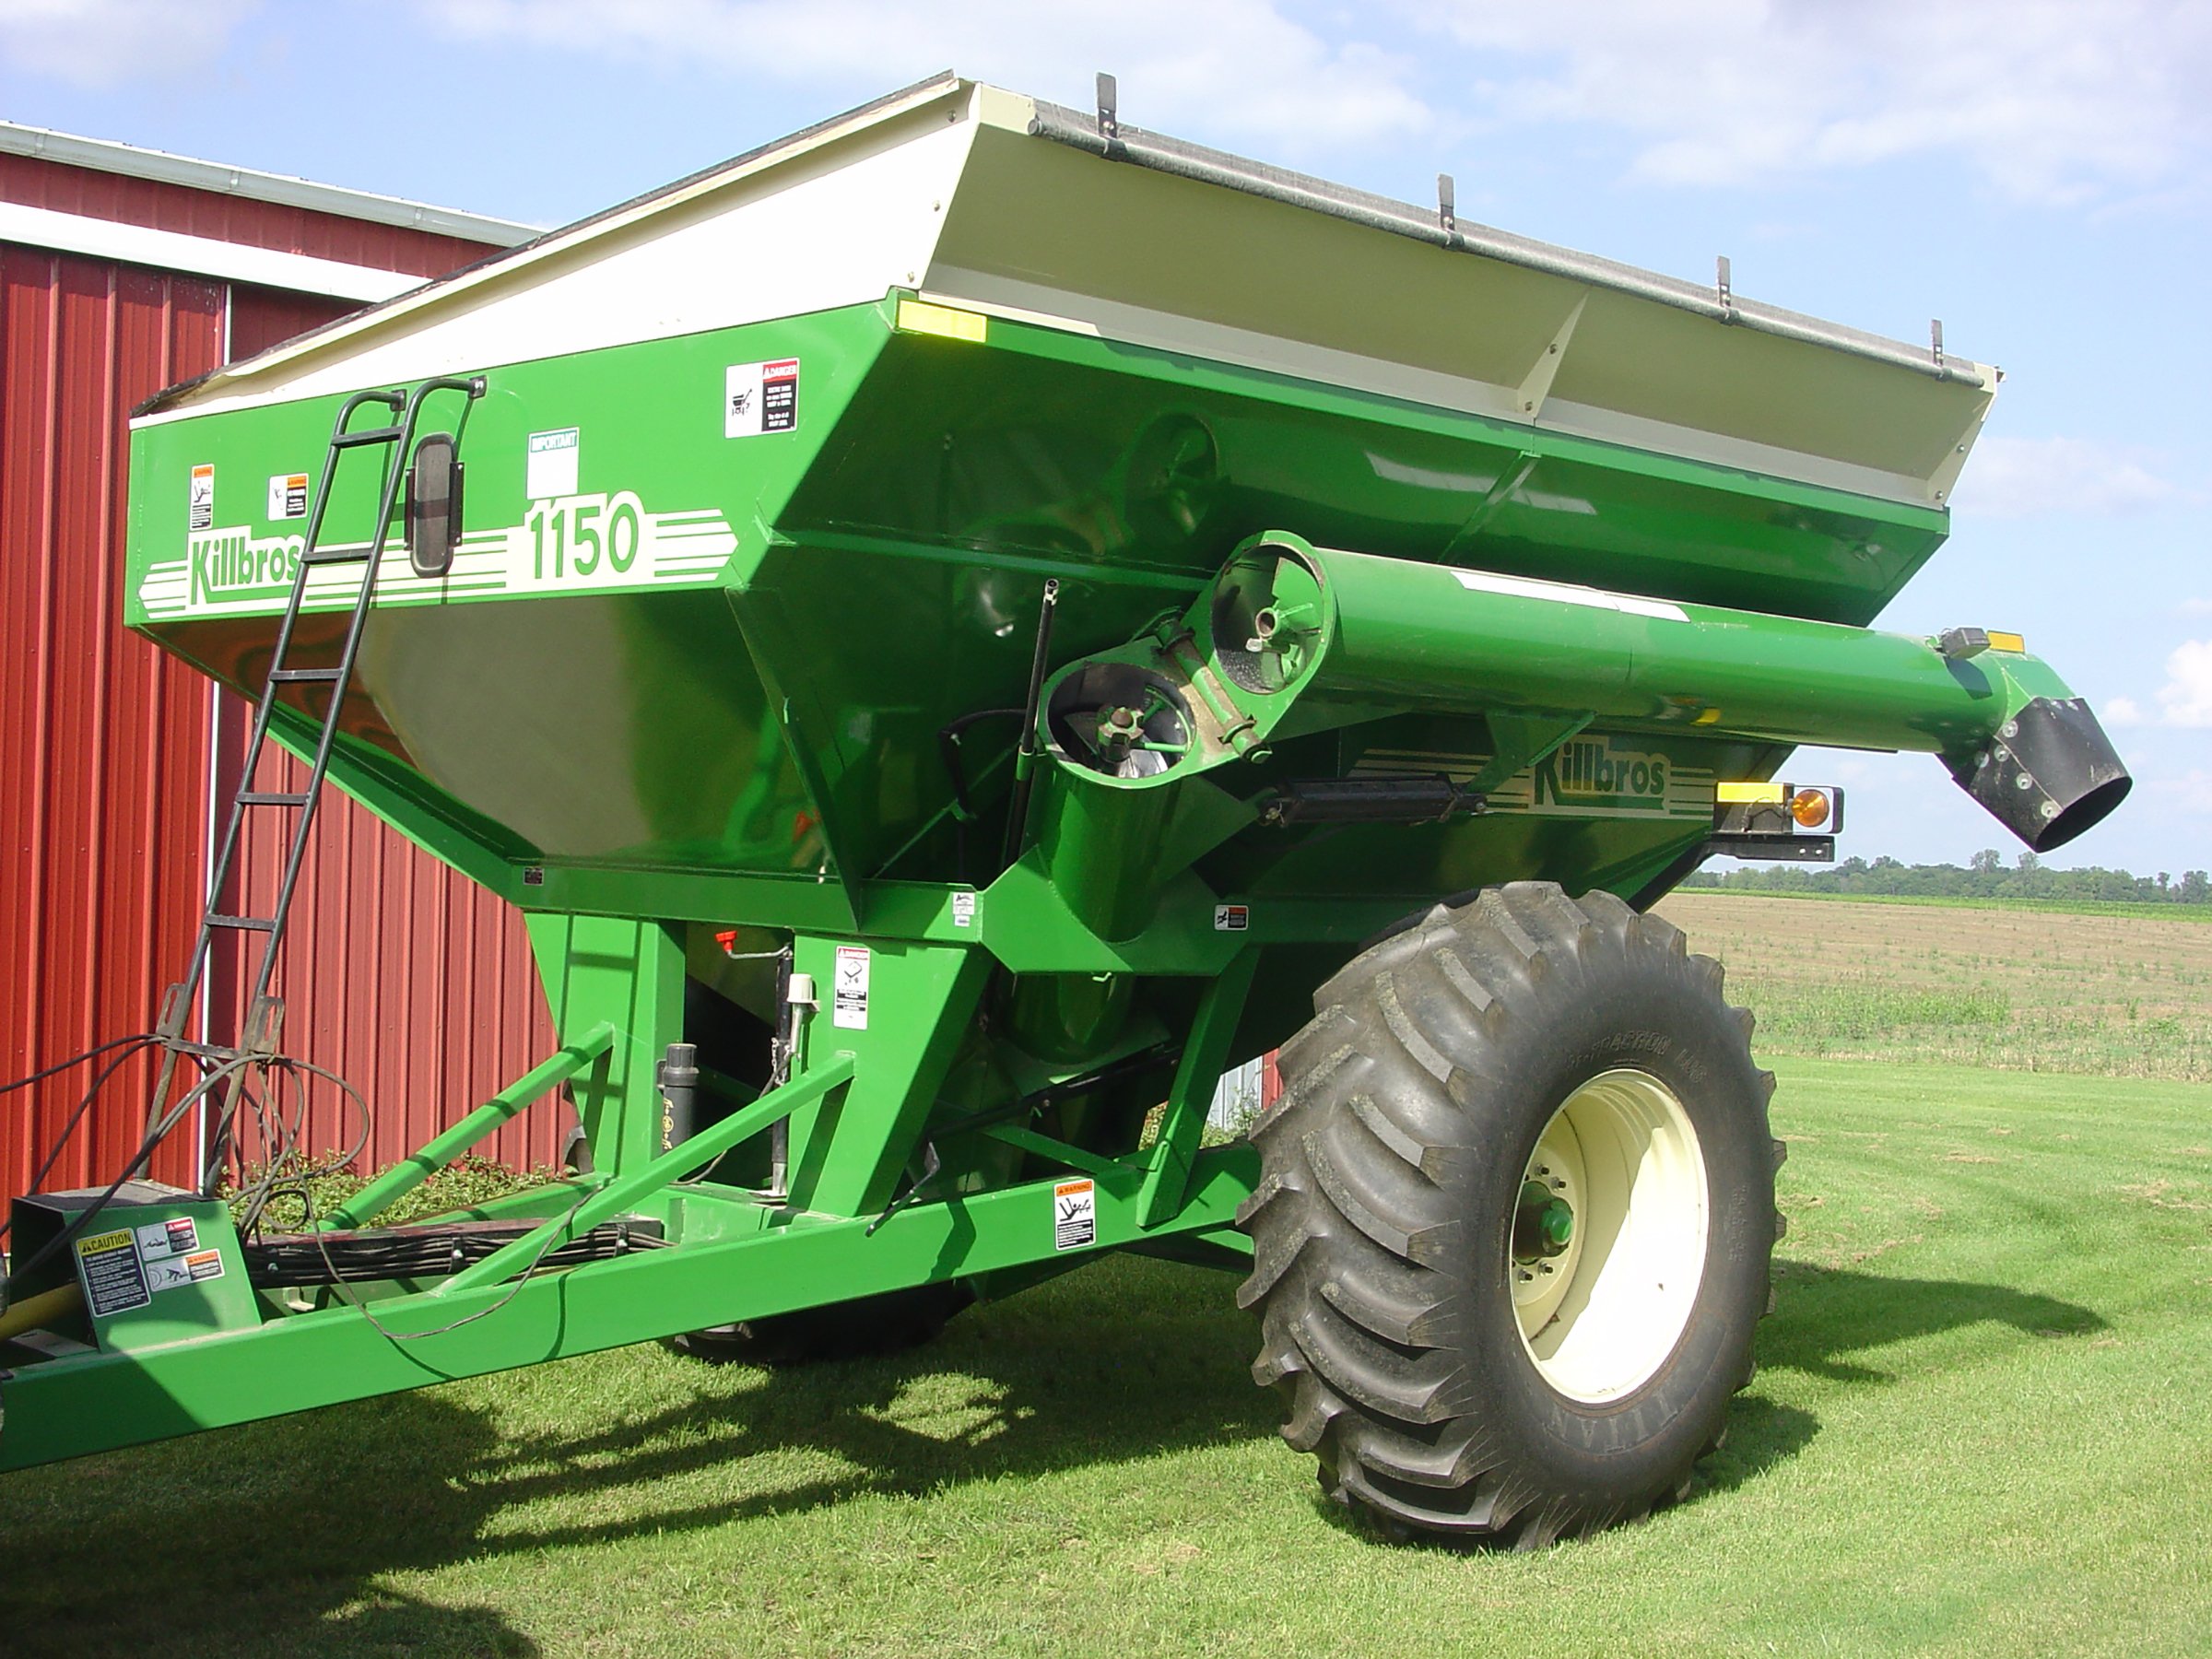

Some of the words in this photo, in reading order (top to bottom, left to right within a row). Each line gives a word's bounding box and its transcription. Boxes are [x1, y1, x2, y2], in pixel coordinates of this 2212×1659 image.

[190, 535, 300, 605] Killbros
[530, 502, 640, 580] 1150
[1534, 741, 1665, 810] Killbros
[91, 1232, 133, 1251] CAUTION
[1542, 1388, 1678, 1453] TITAN
